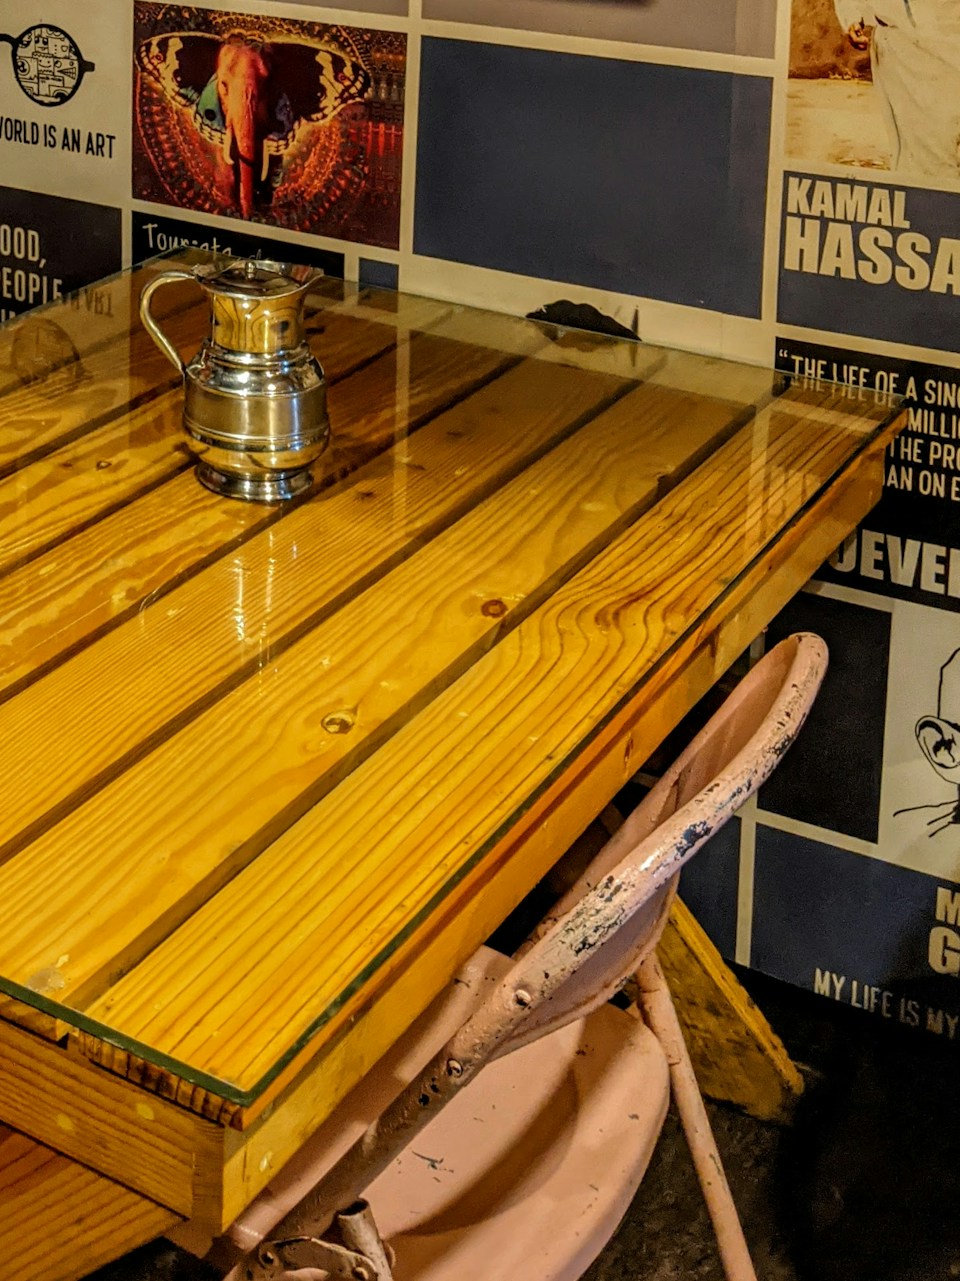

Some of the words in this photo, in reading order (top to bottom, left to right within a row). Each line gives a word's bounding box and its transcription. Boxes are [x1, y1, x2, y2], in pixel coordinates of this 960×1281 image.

[44, 124, 56, 148] IS
[61, 128, 81, 153] AN
[85, 132, 116, 159] ART
[787, 176, 911, 229] KAMAL
[784, 216, 960, 296] HASSA
[875, 370, 899, 396] OF
[905, 376, 918, 401] A
[919, 470, 945, 498] ON
[928, 926, 960, 977] G
[814, 968, 845, 1001] MY
[851, 980, 893, 1018] LIFE
[900, 996, 920, 1026] IS
